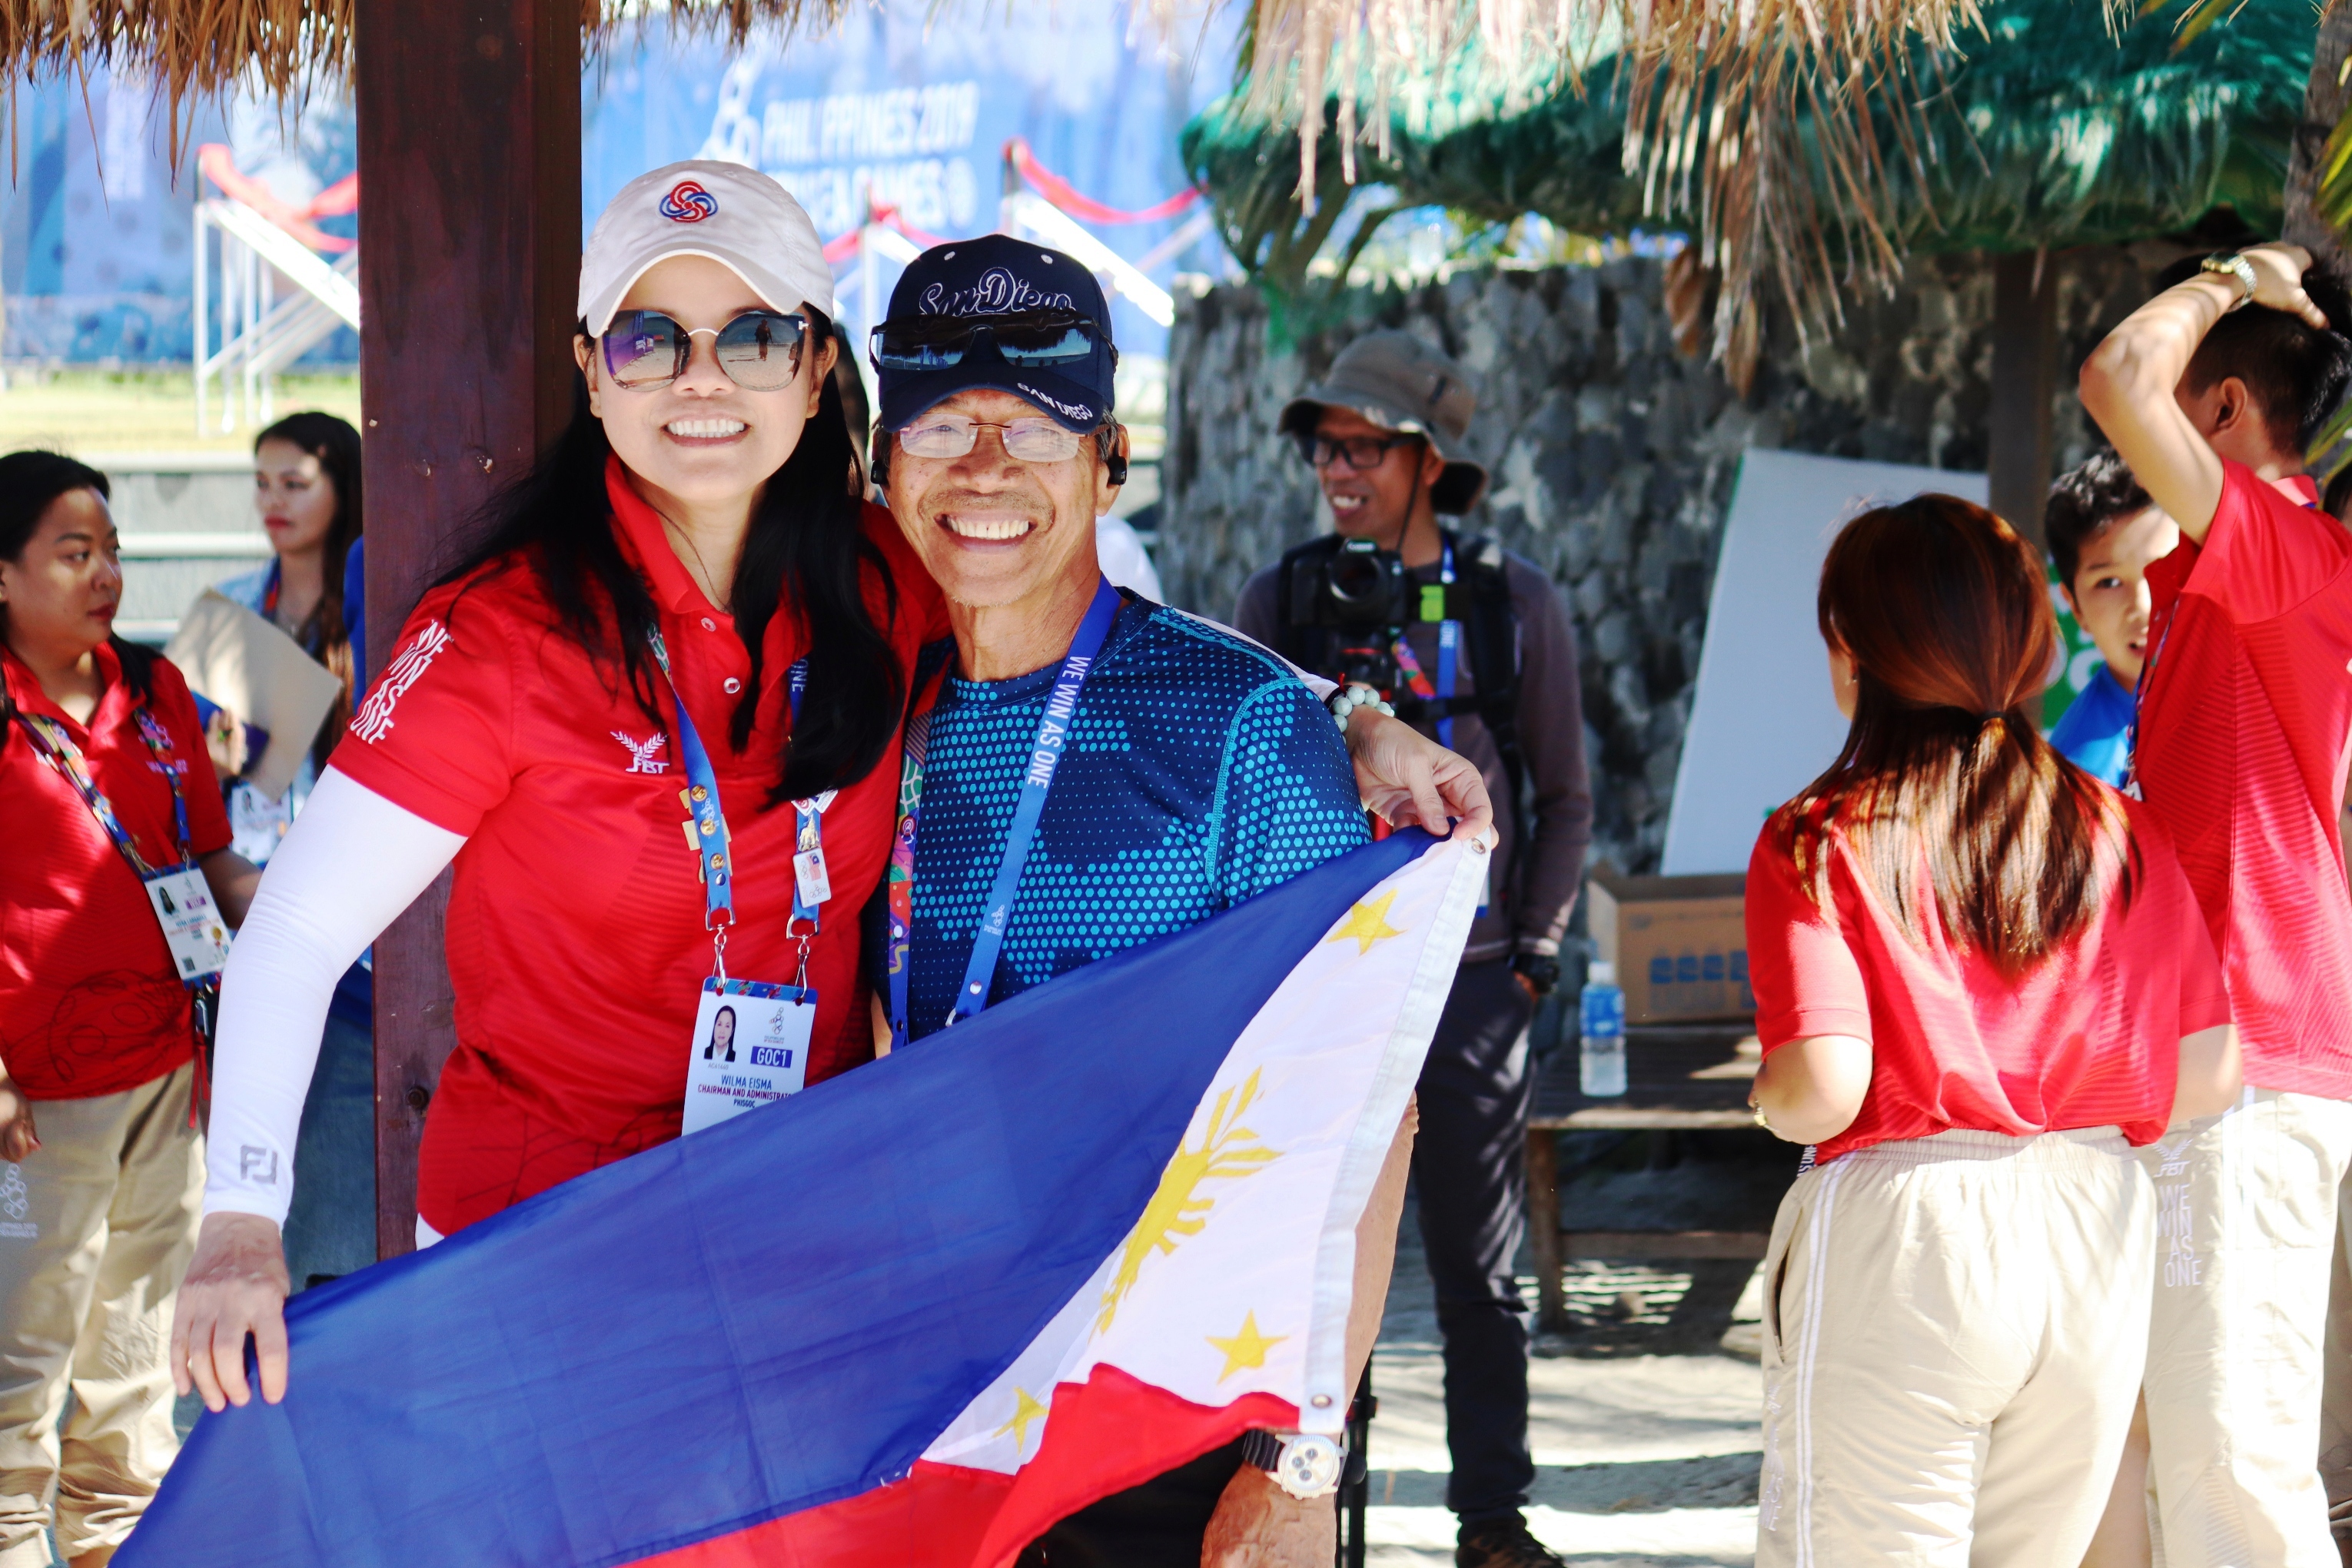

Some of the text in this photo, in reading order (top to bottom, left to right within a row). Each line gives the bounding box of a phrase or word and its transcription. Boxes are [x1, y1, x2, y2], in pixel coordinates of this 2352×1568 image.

[917, 78, 980, 153] 2019
[1017, 383, 1093, 420] SAN DIEGO
[416, 619, 453, 663] WE
[388, 643, 433, 691] WIN
[370, 676, 405, 716] AS
[350, 699, 395, 745] ONE
[1027, 656, 1091, 789] WE WIN AS ONE
[756, 1048, 787, 1067] GOC1
[698, 1084, 731, 1096] CHAIRMAN
[732, 1088, 746, 1098] AND
[721, 1074, 772, 1090] WILMA EISMA
[2159, 1184, 2191, 1211] WE
[2157, 1209, 2193, 1237] WIN
[2169, 1235, 2194, 1261] AS
[2164, 1260, 2203, 1287] ONE
